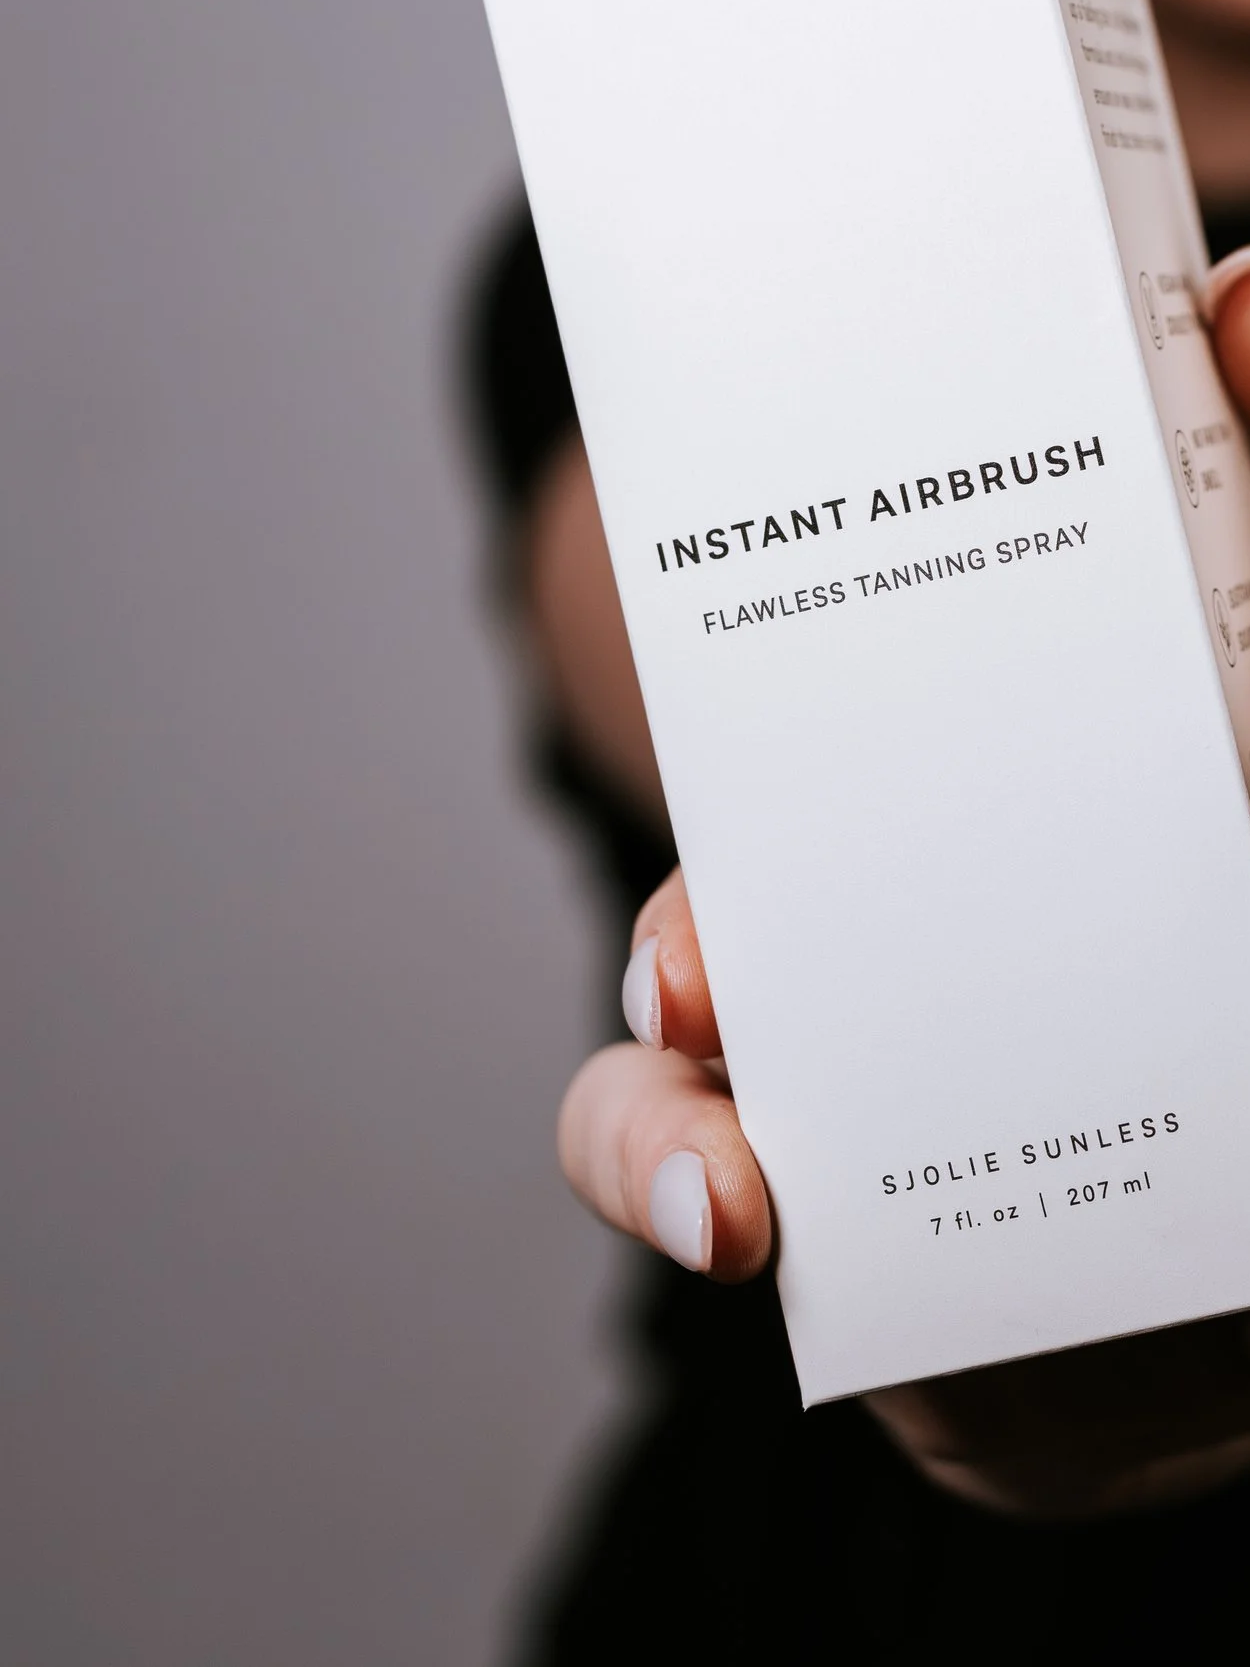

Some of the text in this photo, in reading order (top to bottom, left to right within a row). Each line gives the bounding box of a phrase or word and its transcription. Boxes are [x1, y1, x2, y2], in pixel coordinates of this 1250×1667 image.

[655, 435, 1106, 573] INSTANT AIRBRUSH
[702, 521, 1088, 635] FLAWLESS TANNING SPRAY
[881, 1112, 1180, 1196] SJOLIE SUNLESS
[930, 1216, 942, 1236] 7
[954, 1209, 981, 1231] fl.
[992, 1205, 1020, 1223] oz
[1066, 1180, 1109, 1207] 207
[1122, 1170, 1151, 1195] ml
